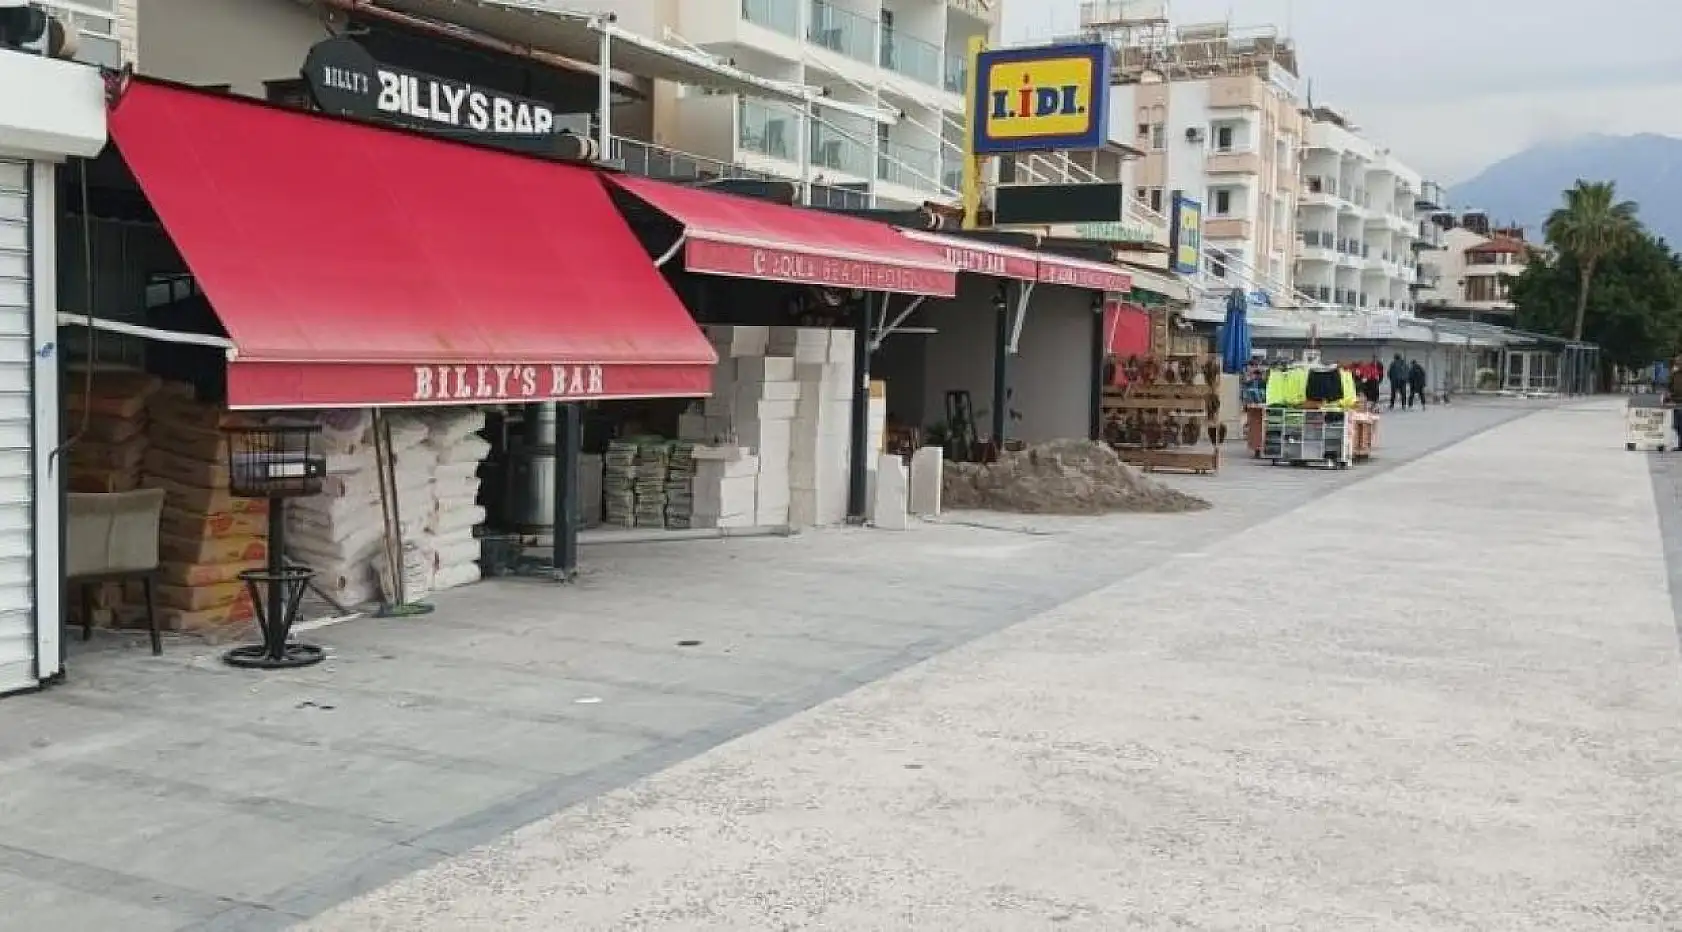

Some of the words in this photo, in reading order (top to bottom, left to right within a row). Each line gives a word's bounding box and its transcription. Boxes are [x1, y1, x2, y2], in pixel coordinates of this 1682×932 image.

[377, 70, 489, 131] BILLY'S
[493, 97, 553, 133] BAR
[414, 364, 537, 400] BILLY'S
[551, 364, 604, 394] BAR
